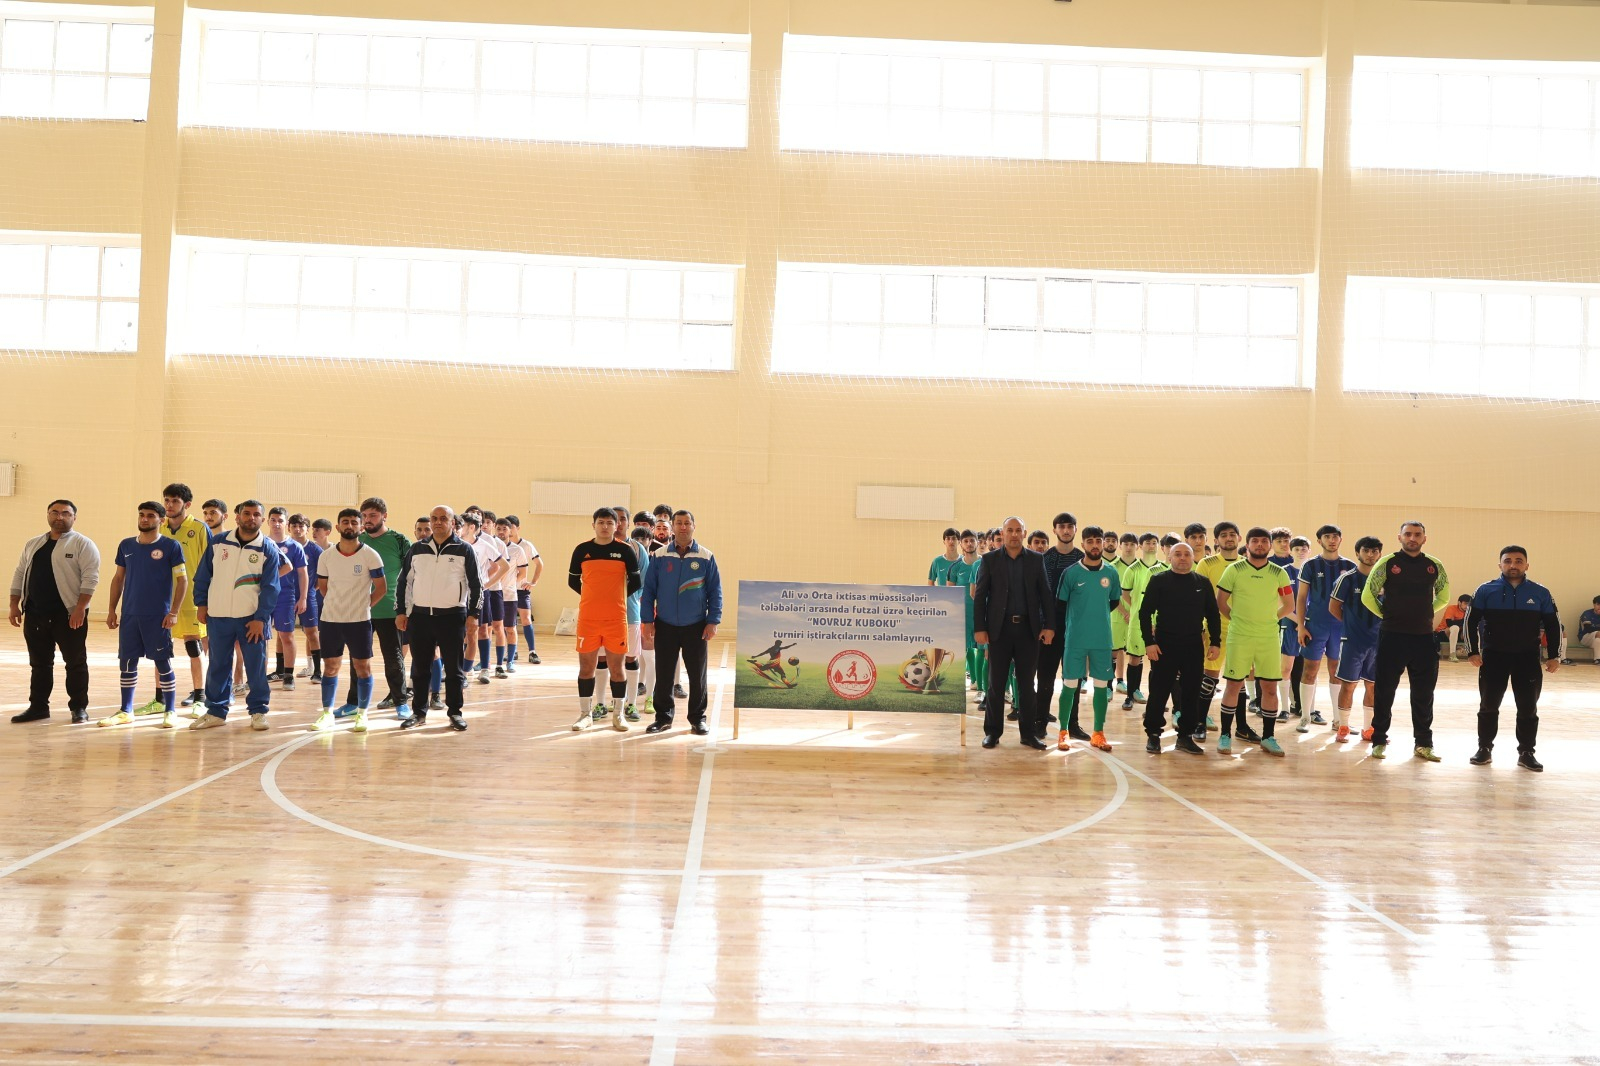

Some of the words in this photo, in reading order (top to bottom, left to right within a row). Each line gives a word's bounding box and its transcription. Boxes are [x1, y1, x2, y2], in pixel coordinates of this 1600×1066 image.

[781, 590, 794, 599] Ali
[798, 592, 808, 600] və
[812, 591, 832, 600] Orta
[836, 592, 866, 601] ixtisas
[870, 592, 927, 602] müəssisələri
[760, 603, 806, 612] tələbələri
[808, 604, 849, 614] arasında
[852, 606, 880, 615] futzal
[883, 606, 904, 616] üzrə
[906, 607, 947, 618] keçirilən
[578, 636, 585, 648] 7
[773, 630, 804, 640] turniri
[807, 630, 870, 642] iştirakçılarını
